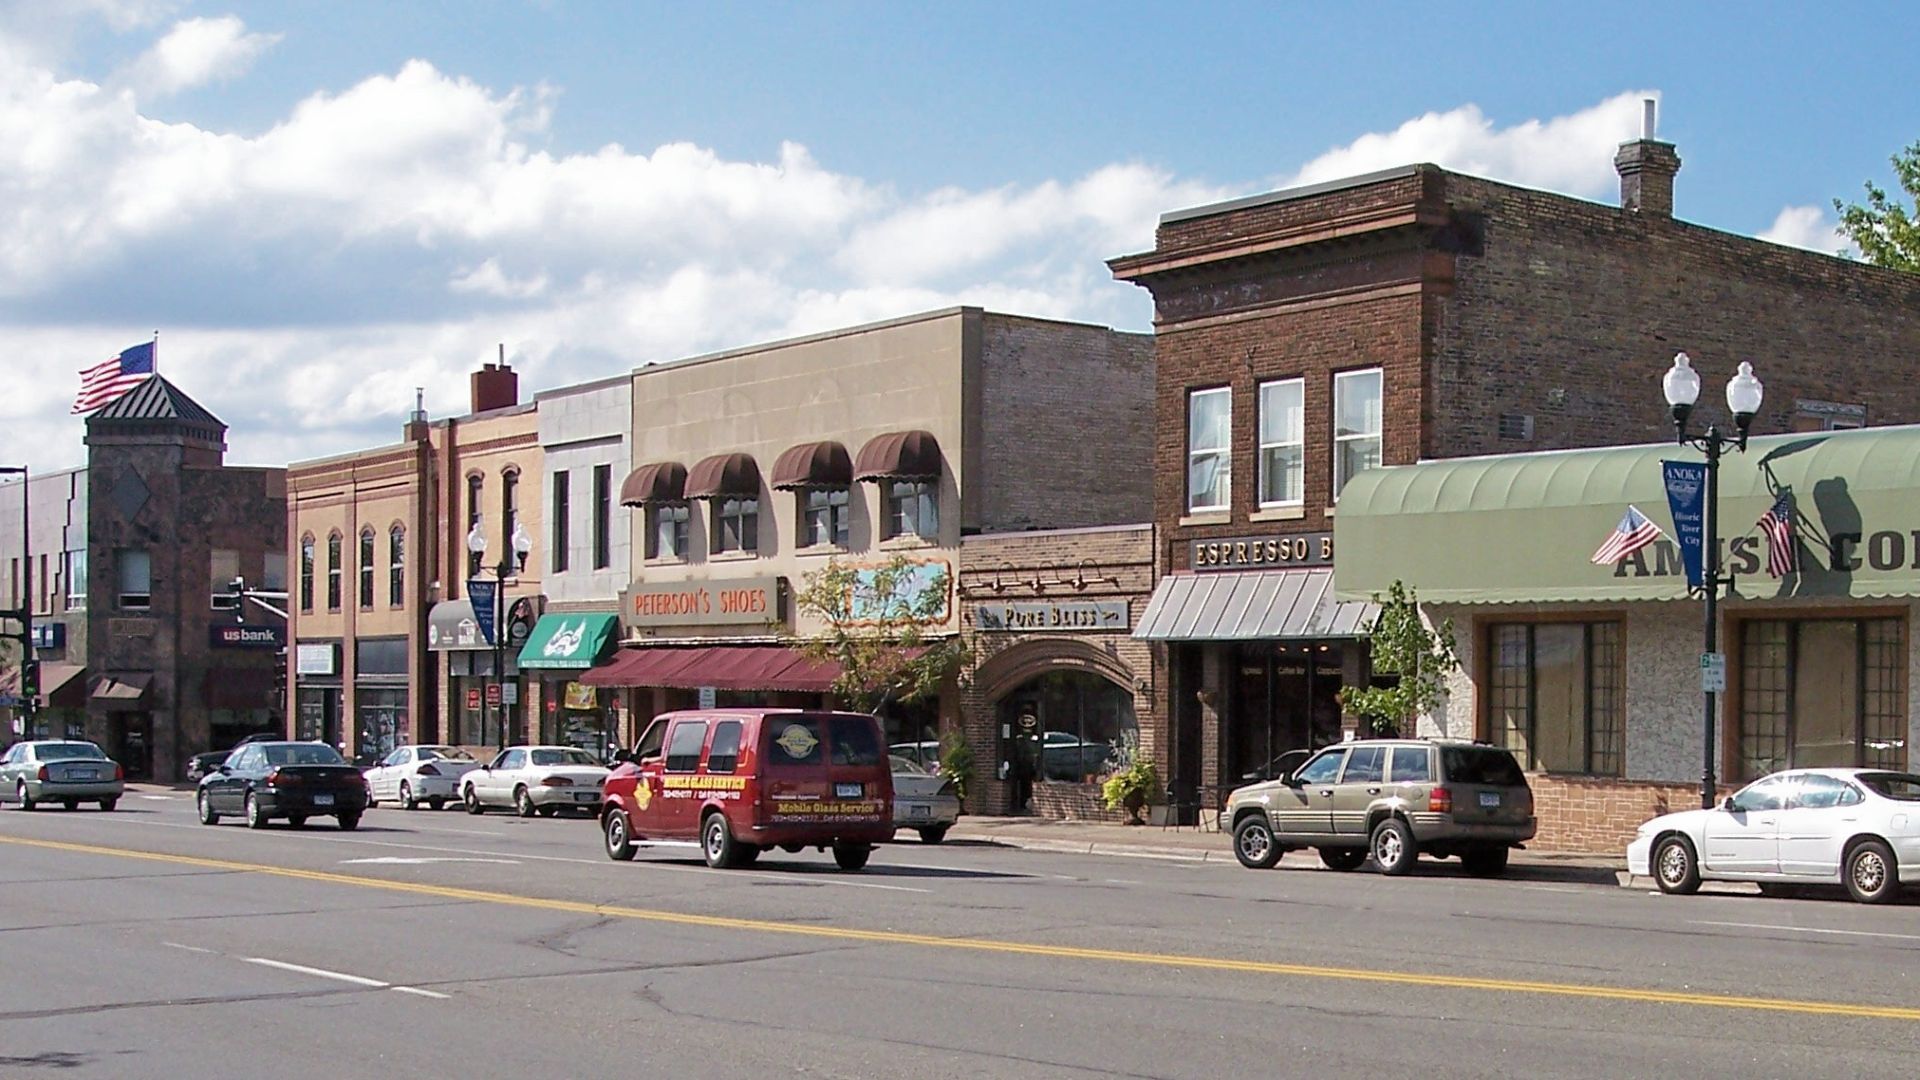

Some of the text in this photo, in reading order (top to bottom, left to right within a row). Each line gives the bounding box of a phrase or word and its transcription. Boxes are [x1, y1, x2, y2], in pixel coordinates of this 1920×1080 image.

[1665, 468, 1702, 480] ANOKA
[1684, 536, 1700, 547] City
[1195, 537, 1309, 565] ESPRESSO
[635, 587, 766, 616] PETERSON'S SHOES
[1051, 607, 1098, 627] BLISS
[778, 803, 874, 813] Mobile Glass Service
